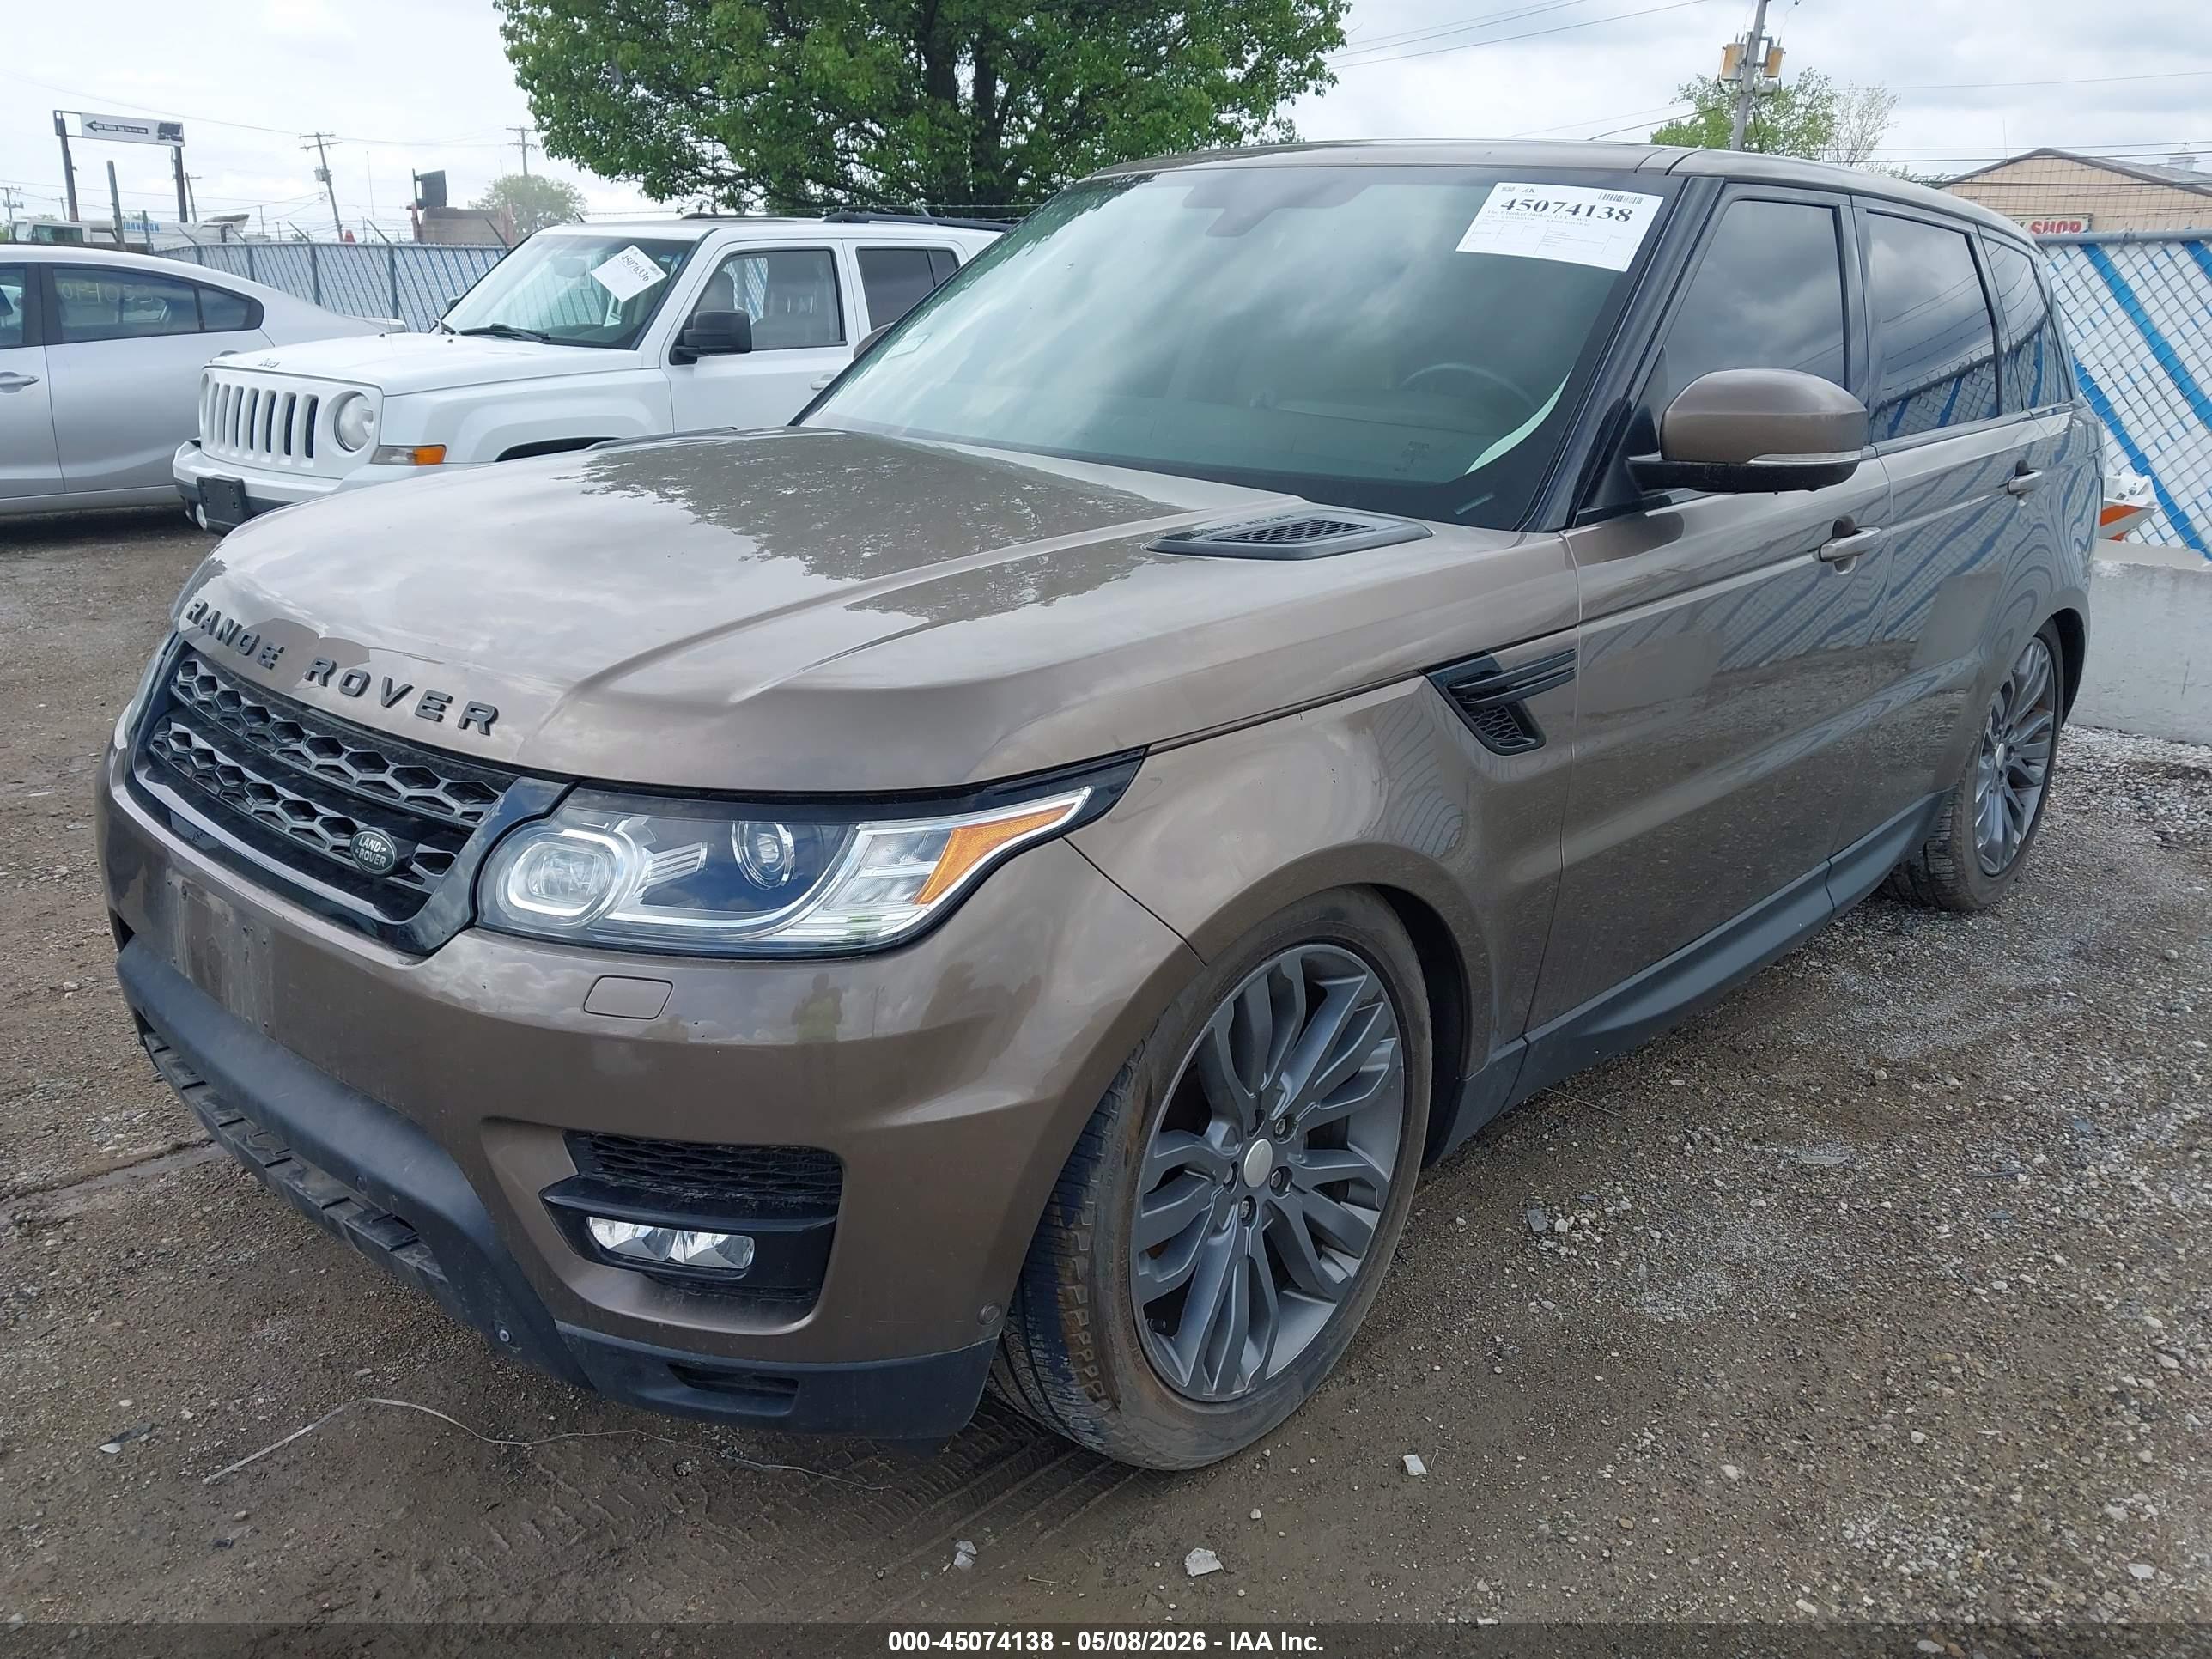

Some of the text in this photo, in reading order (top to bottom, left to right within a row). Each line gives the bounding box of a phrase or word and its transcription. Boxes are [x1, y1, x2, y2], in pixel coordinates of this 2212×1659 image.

[1500, 198, 1633, 222] 45074138
[2031, 221, 2082, 234] SHOP
[185, 598, 501, 737] RANGE ROVER
[358, 835, 382, 853] LAND
[358, 848, 386, 868] ROVER
